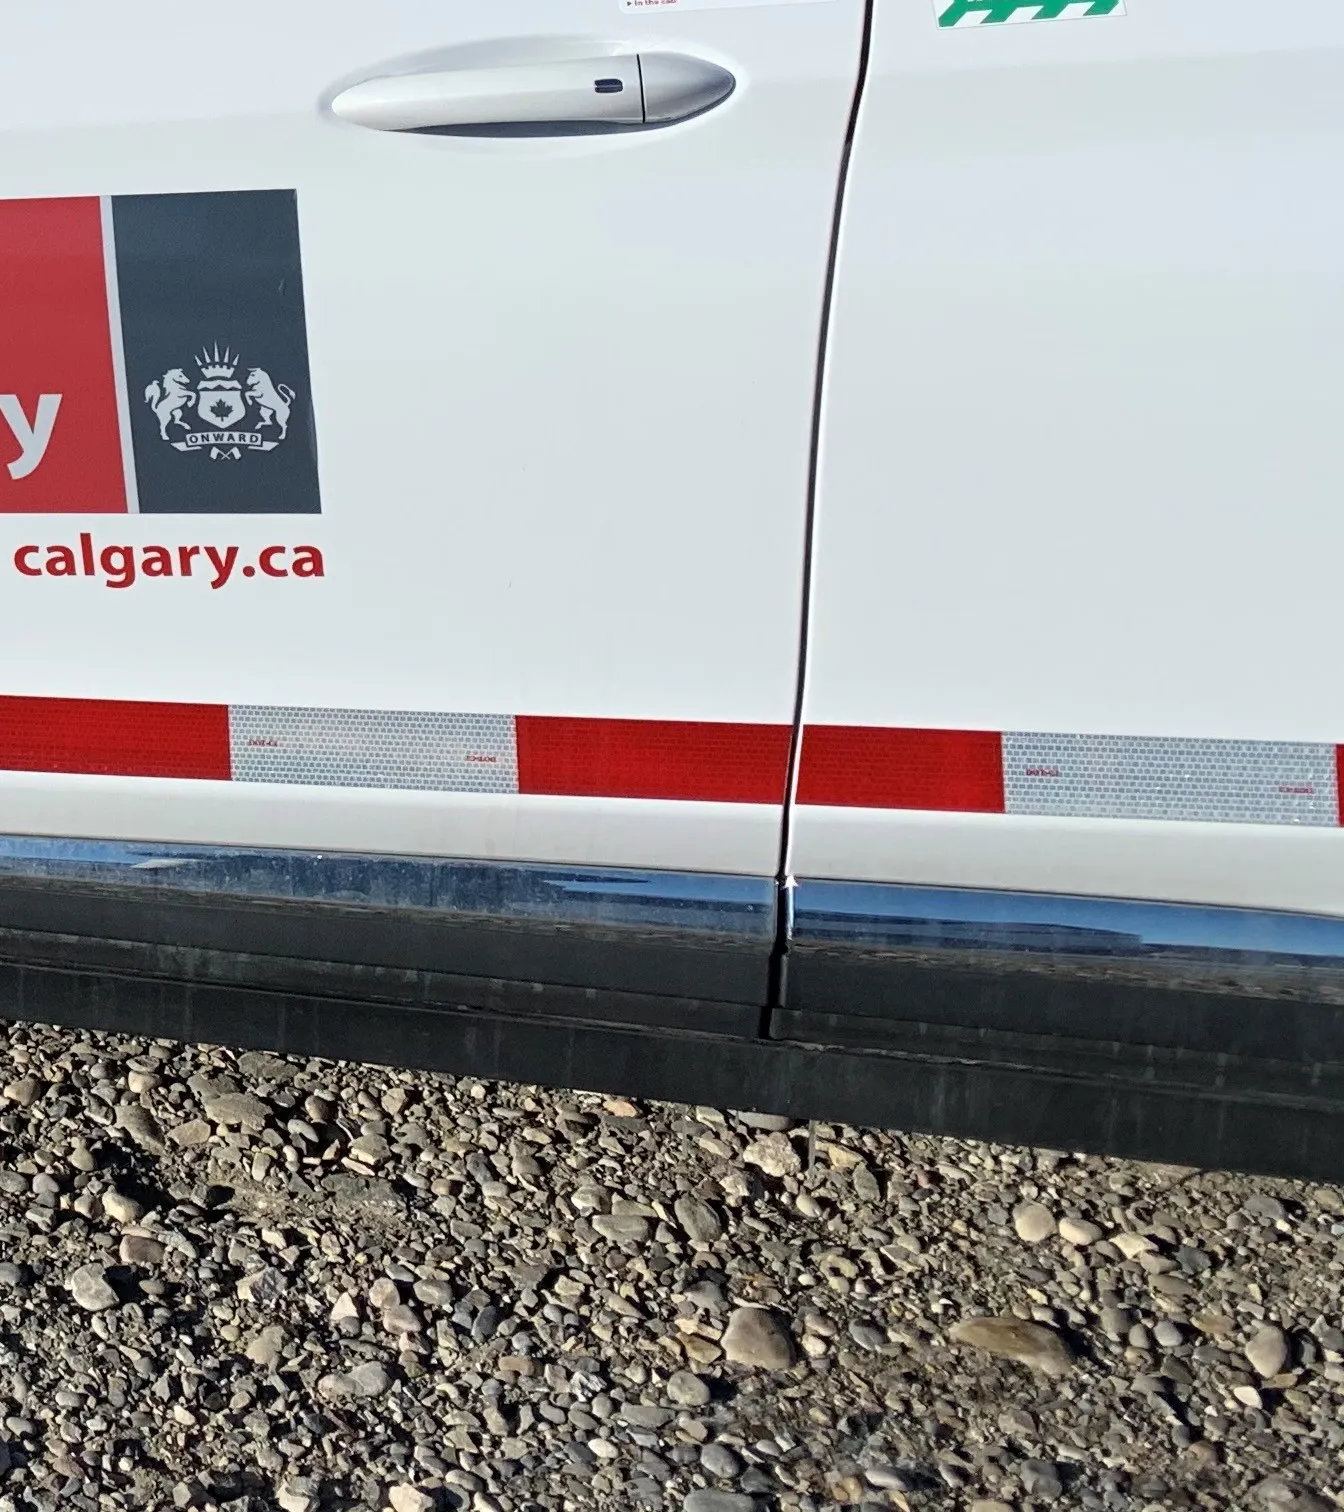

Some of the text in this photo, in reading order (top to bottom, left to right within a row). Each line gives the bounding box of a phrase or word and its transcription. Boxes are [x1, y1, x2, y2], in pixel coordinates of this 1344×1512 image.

[634, 0, 643, 7] In
[188, 433, 259, 444] ONWARD
[13, 532, 325, 590] calgary.ca
